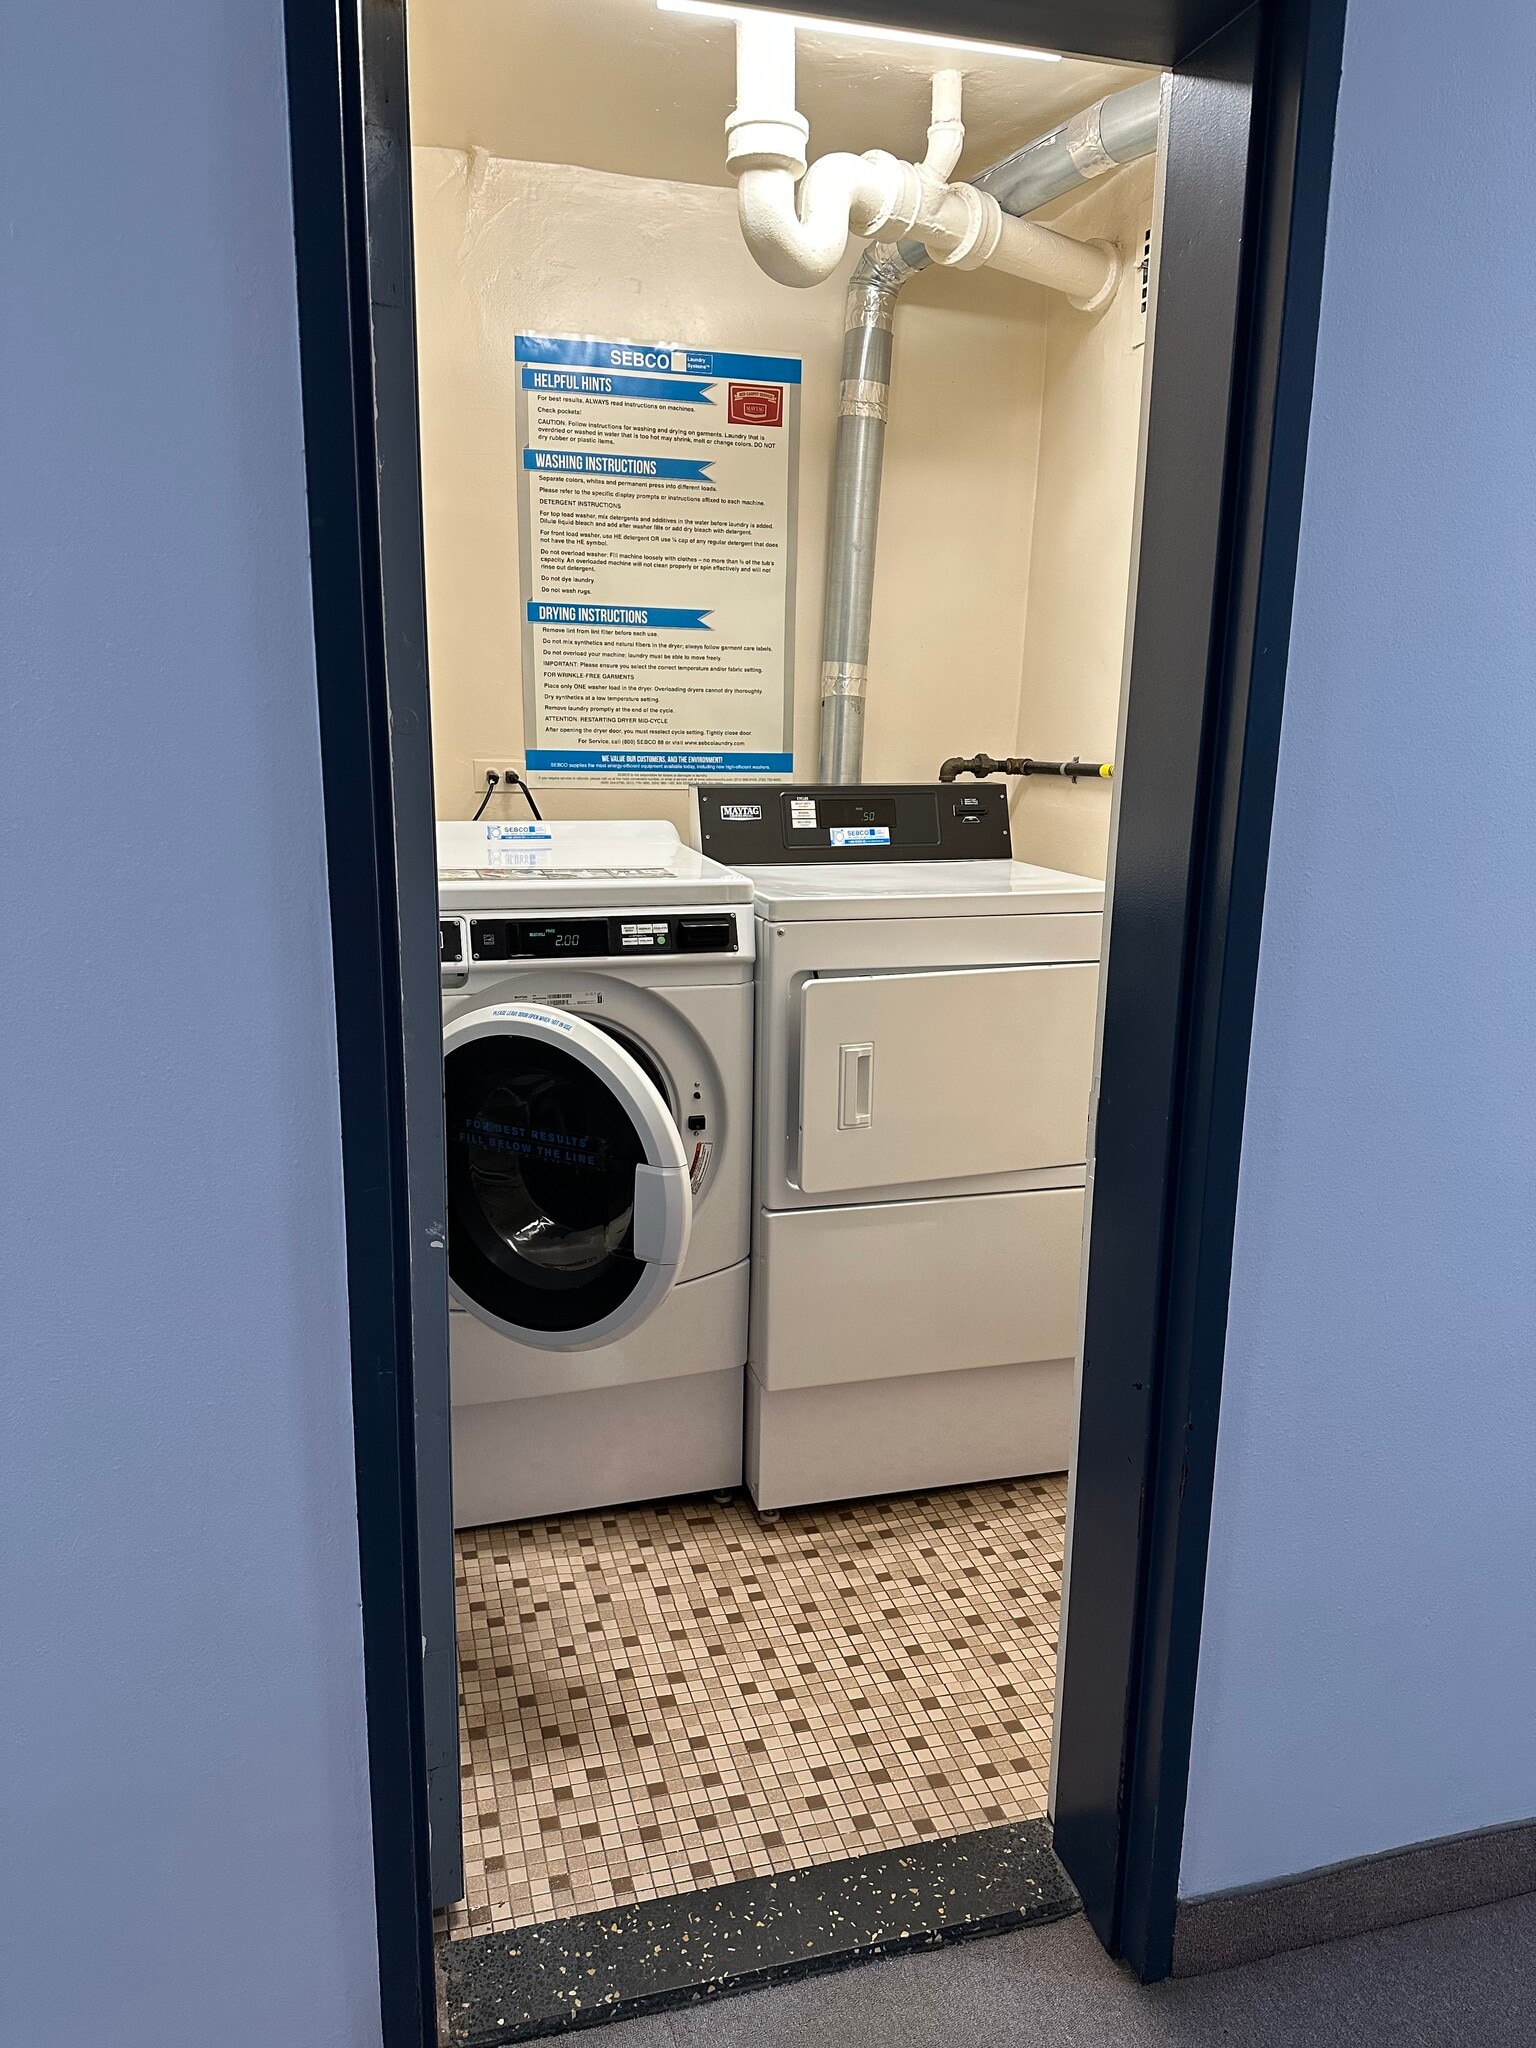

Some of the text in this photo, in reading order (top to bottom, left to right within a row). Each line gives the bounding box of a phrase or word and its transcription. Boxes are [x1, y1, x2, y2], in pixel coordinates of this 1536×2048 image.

[610, 349, 670, 369] SEBCO
[687, 356, 706, 364] Laundry
[534, 373, 612, 392] HELPFUL HINTS
[584, 397, 609, 406] ALWAYS
[624, 401, 657, 409] instructions
[537, 406, 556, 414] Check
[588, 422, 622, 430] instructions
[632, 425, 656, 433] washing
[668, 428, 686, 436] drying
[724, 432, 747, 440] Laundry
[577, 436, 596, 444] plastic
[713, 439, 733, 447] change
[535, 453, 657, 475] WASHING INSTRUCTIONS
[538, 474, 564, 483] Separate
[617, 480, 647, 488] permanent
[591, 489, 613, 497] specific
[614, 491, 635, 499] display
[636, 493, 659, 501] prompts
[539, 498, 621, 509] DETERGENT INSTRUCTIONS
[539, 605, 648, 624] DRYING INSTRUCTIONS
[723, 807, 759, 815] MAYTAG
[555, 934, 579, 946] 2.00
[465, 1118, 588, 1148] FOR BEST RESULTS
[459, 1132, 595, 1165] FILL BELOW THE LINE
